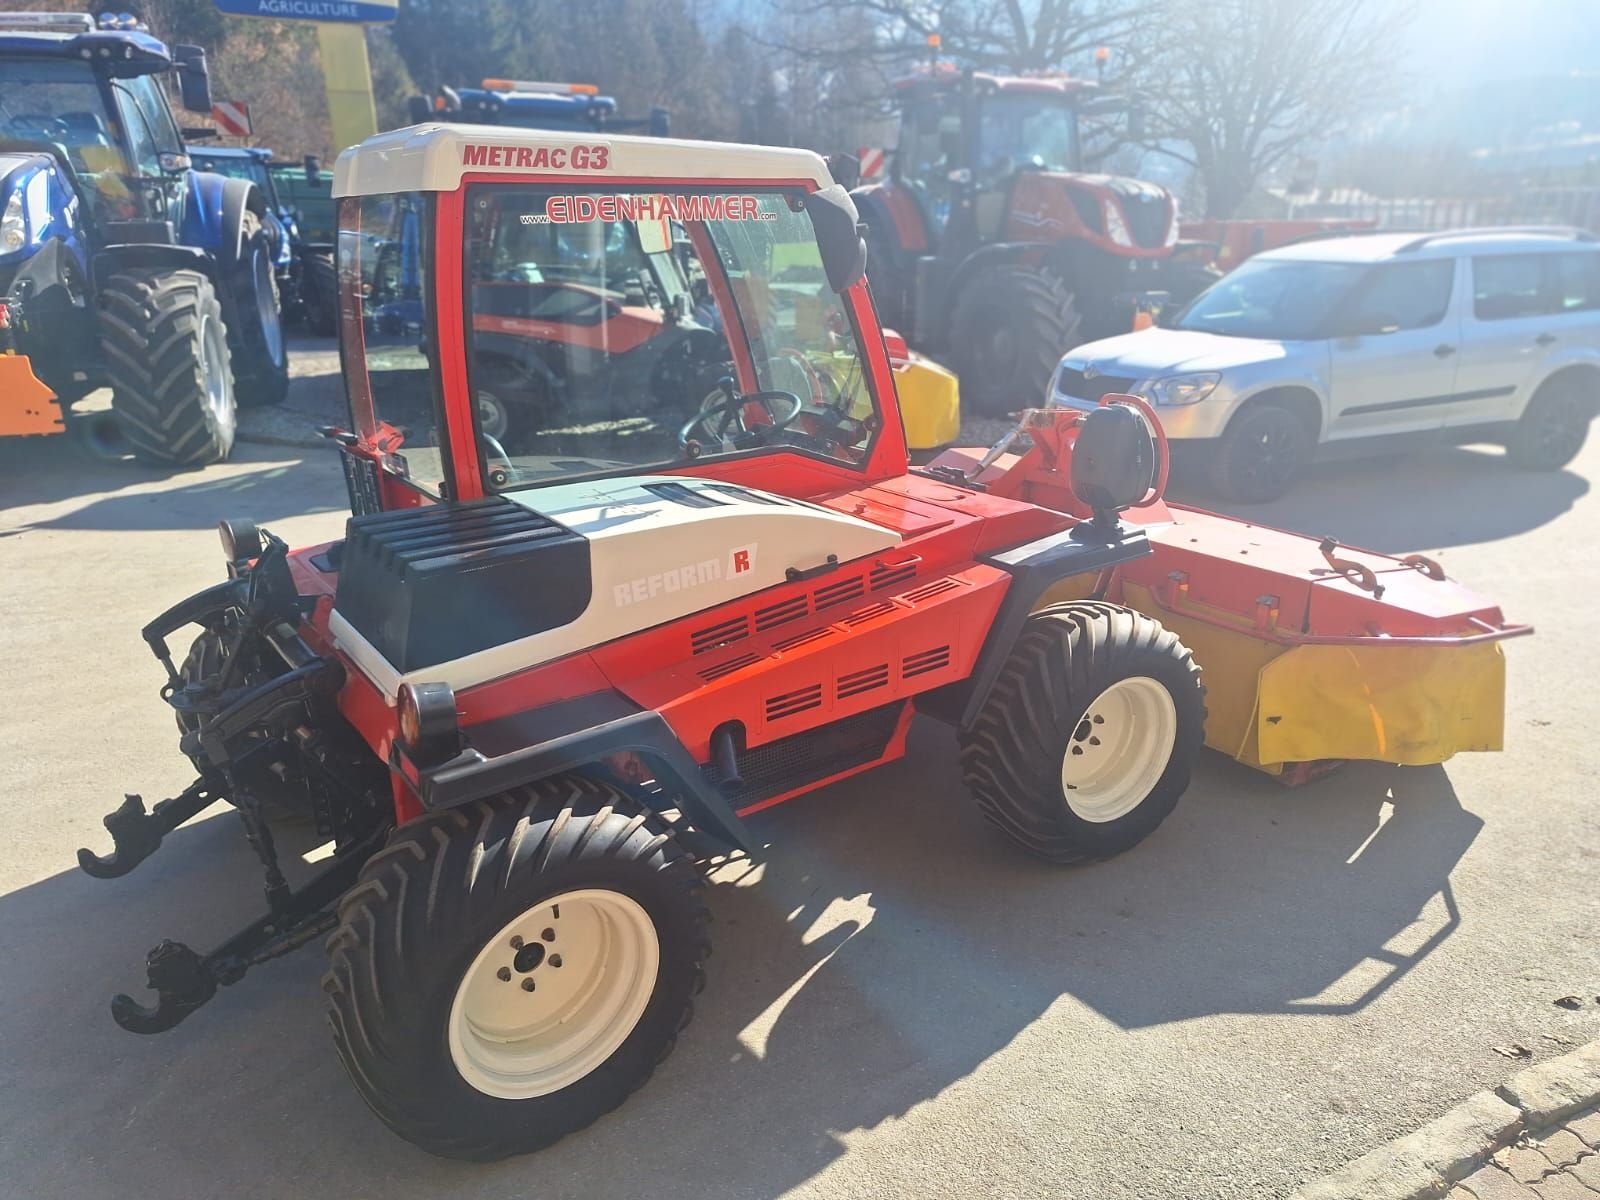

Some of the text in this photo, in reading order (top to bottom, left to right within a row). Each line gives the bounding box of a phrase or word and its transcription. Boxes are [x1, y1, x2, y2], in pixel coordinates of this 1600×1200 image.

[257, 0, 358, 17] AGRICULTURE
[462, 144, 609, 169] METRAC G3
[613, 550, 750, 607] REFORM R
